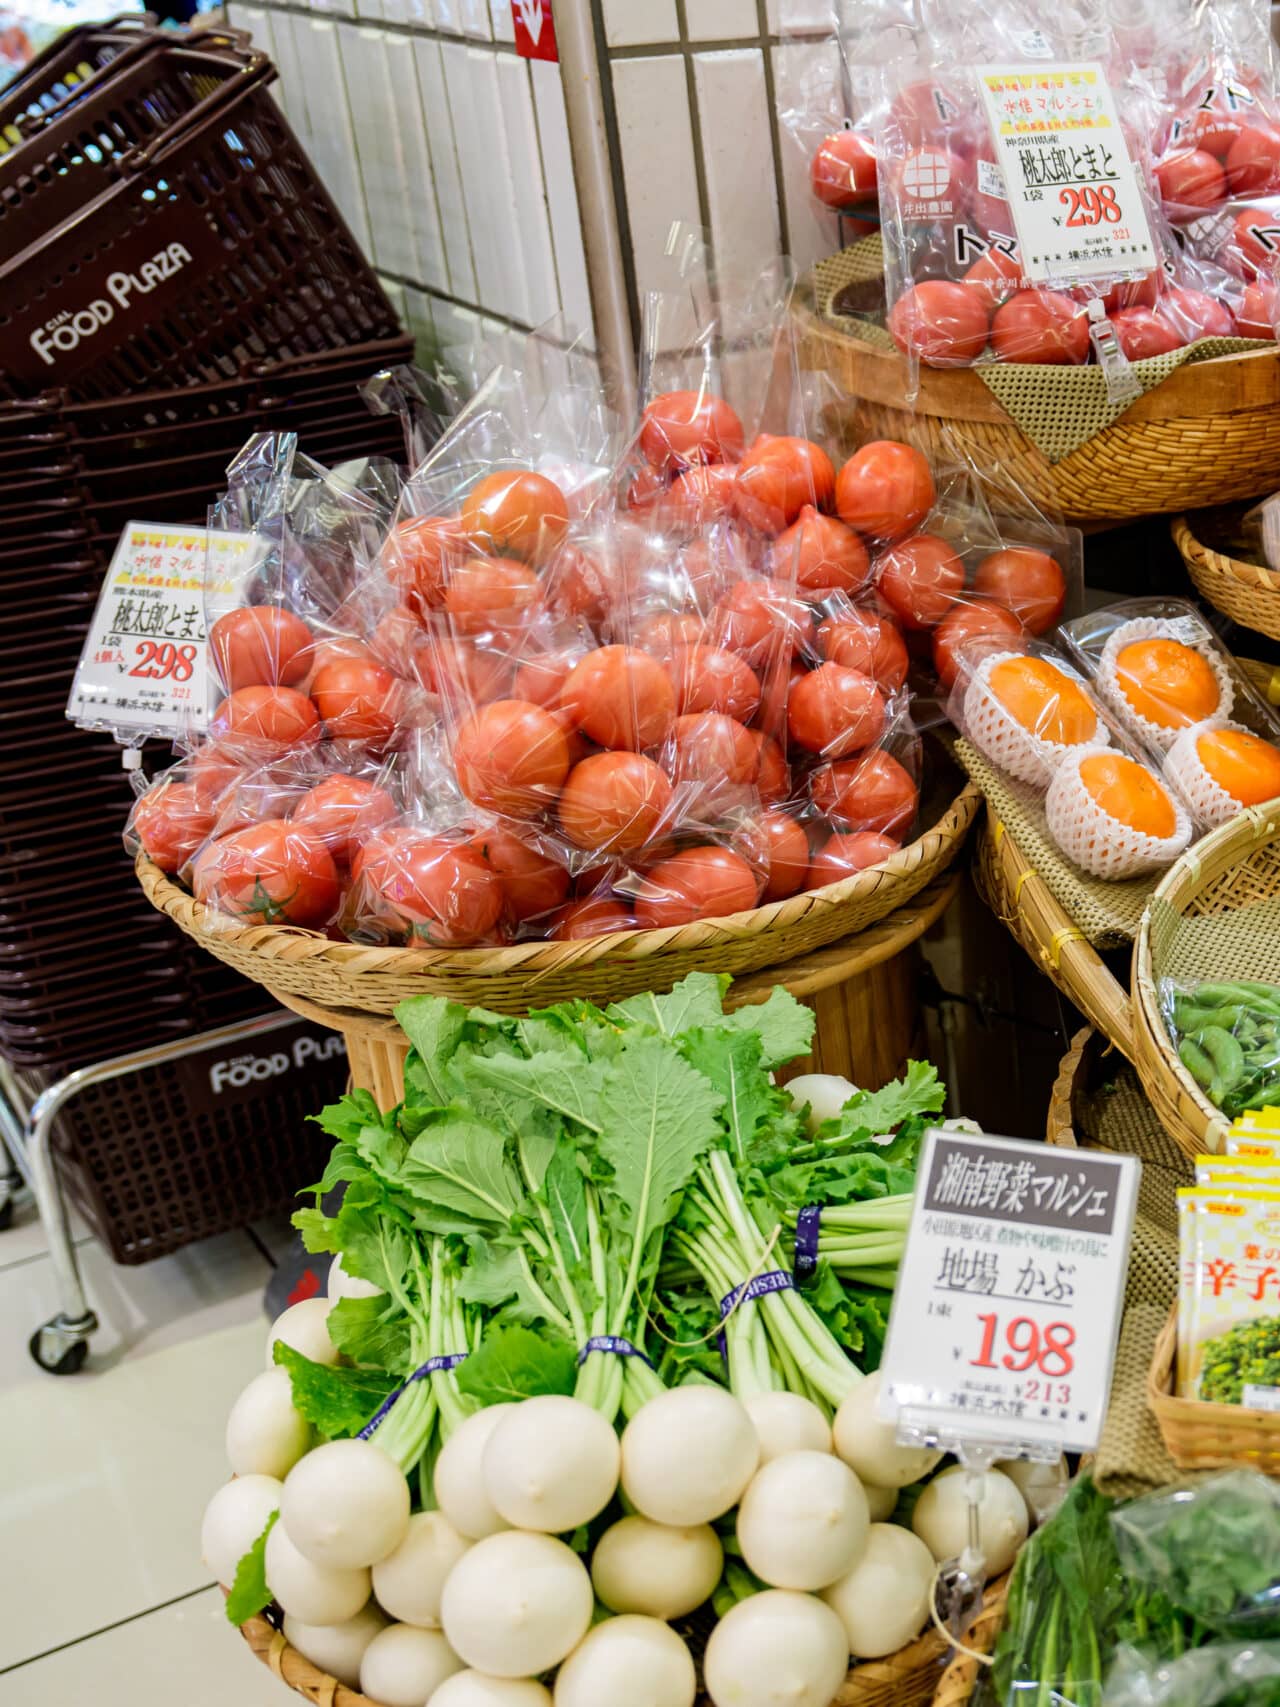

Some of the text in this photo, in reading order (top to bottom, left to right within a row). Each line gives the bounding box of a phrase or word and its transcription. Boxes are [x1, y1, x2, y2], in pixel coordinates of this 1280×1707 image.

[1018, 144, 1118, 185] 桃太郎とまと
[1059, 185, 1122, 227] 298
[956, 226, 1017, 263] トマ
[30, 242, 193, 365] FOOD PLAZA
[128, 640, 198, 682] 298
[210, 1036, 346, 1094] FOOD PLA
[933, 1150, 1110, 1218] 湘南野菜マルシェ
[936, 1246, 1078, 1301] 地場 かぶ
[968, 1311, 1078, 1378] 198
